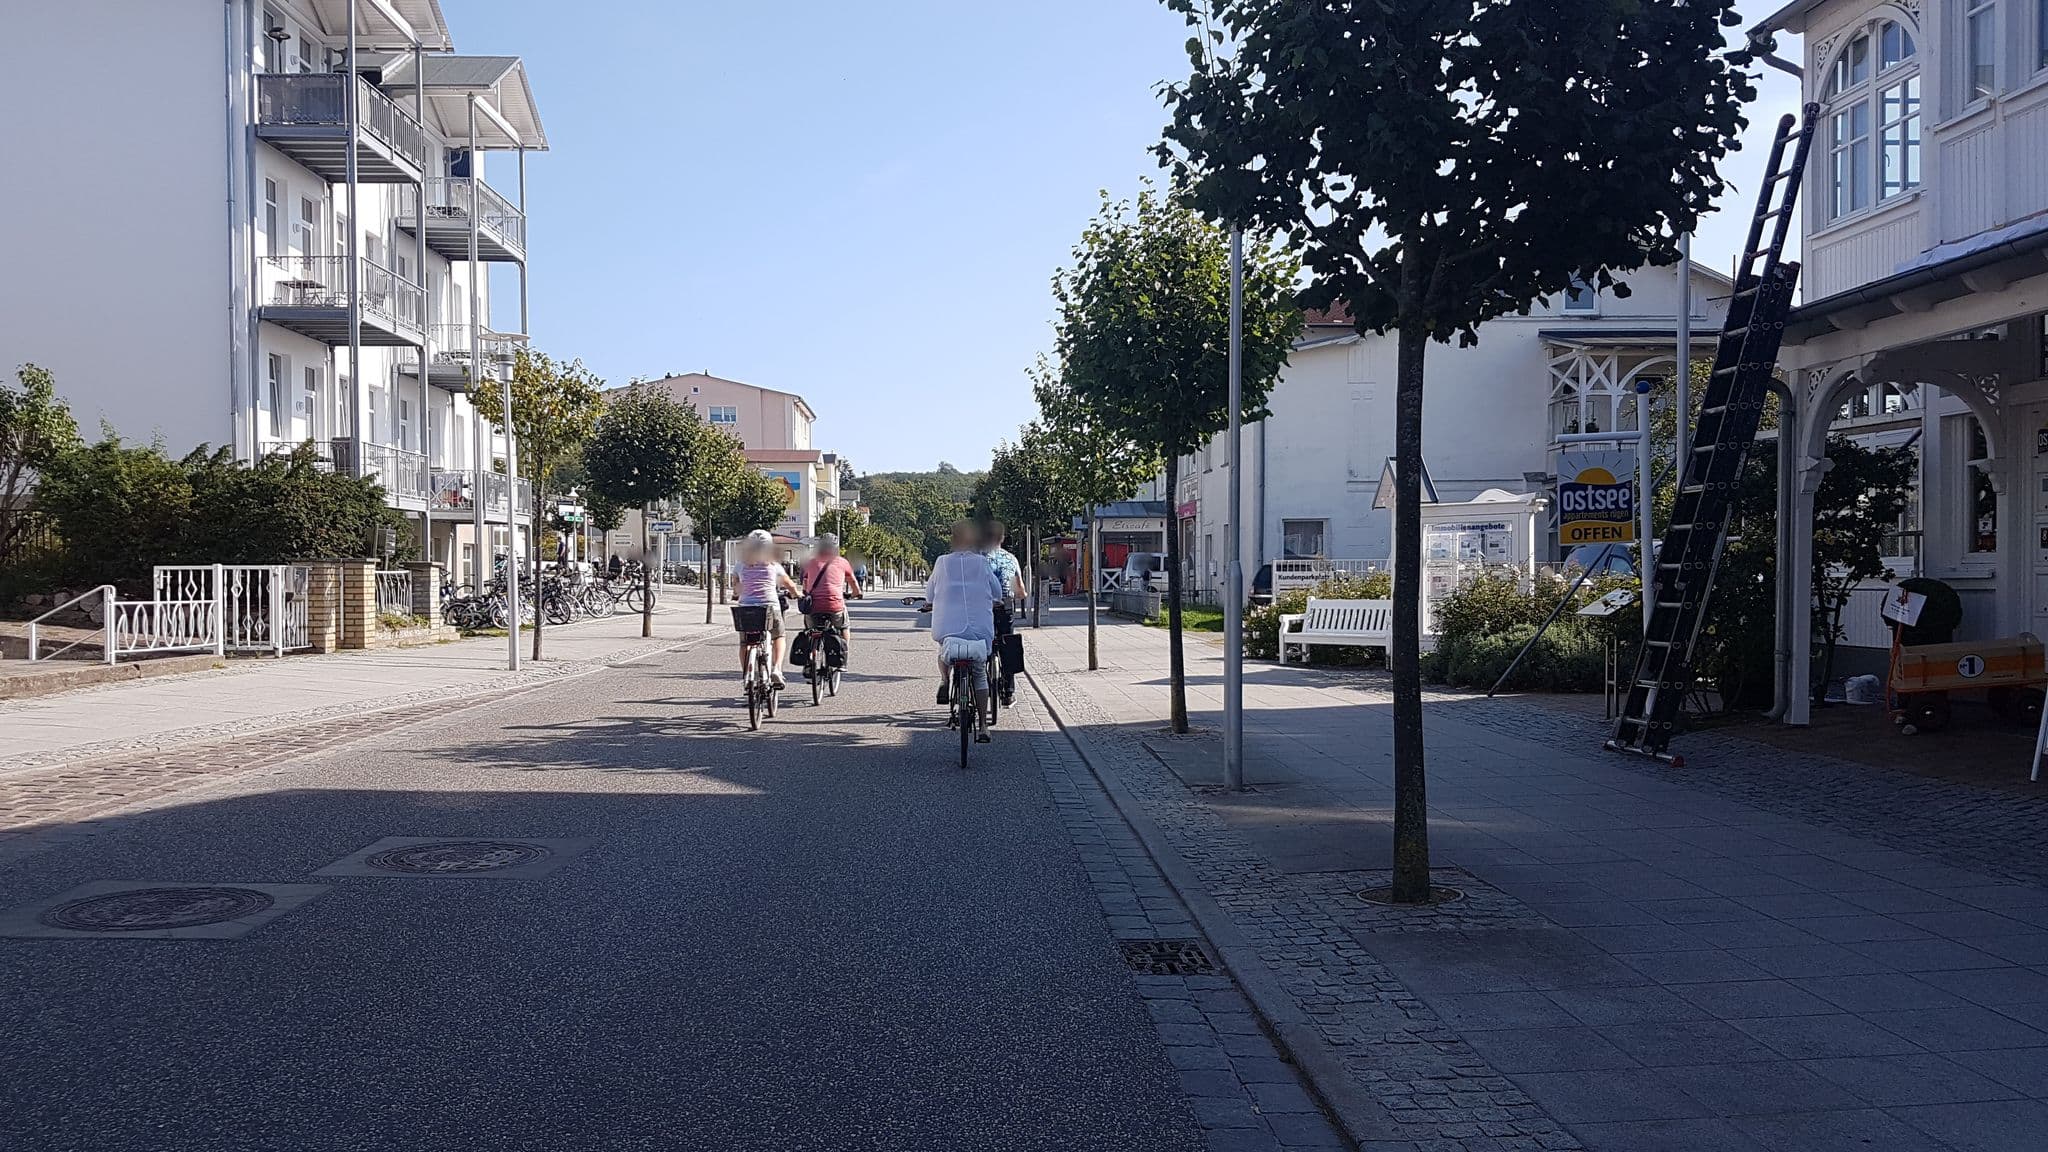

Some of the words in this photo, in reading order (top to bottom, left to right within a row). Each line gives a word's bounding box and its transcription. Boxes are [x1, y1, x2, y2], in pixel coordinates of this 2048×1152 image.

[1562, 485, 1630, 511] ostsee
[1431, 523, 1506, 532] Immobilienangebote
[1571, 526, 1622, 540] OFFEN
